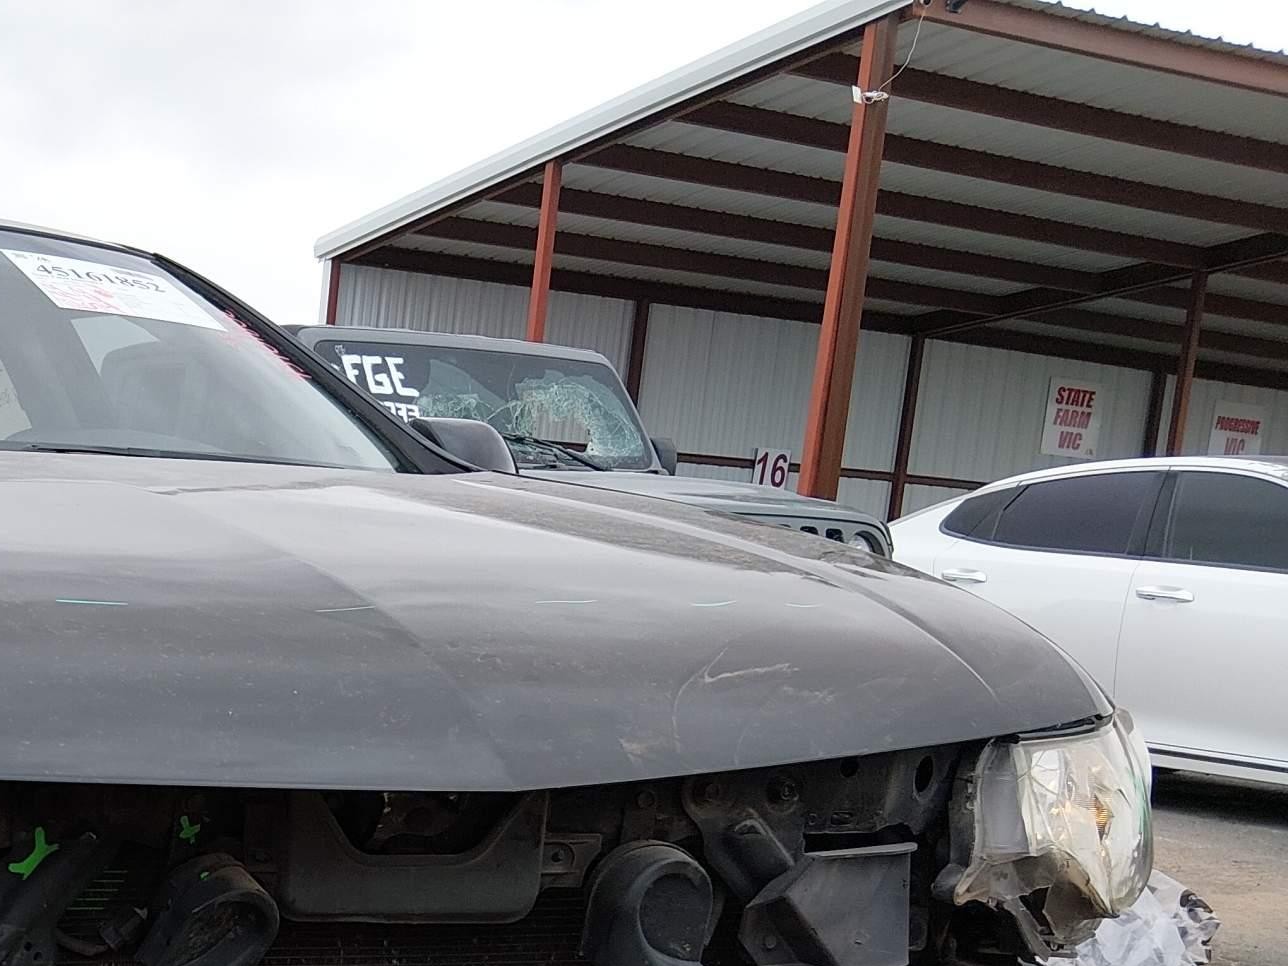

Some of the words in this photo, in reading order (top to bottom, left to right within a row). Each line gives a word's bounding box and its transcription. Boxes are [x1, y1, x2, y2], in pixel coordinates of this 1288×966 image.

[332, 354, 420, 397] FGE
[1056, 386, 1096, 408] STATE
[1053, 407, 1092, 430] FARM
[1215, 415, 1261, 436] PROGRESSIVE
[1058, 430, 1083, 450] VIC
[756, 452, 788, 489] 16
